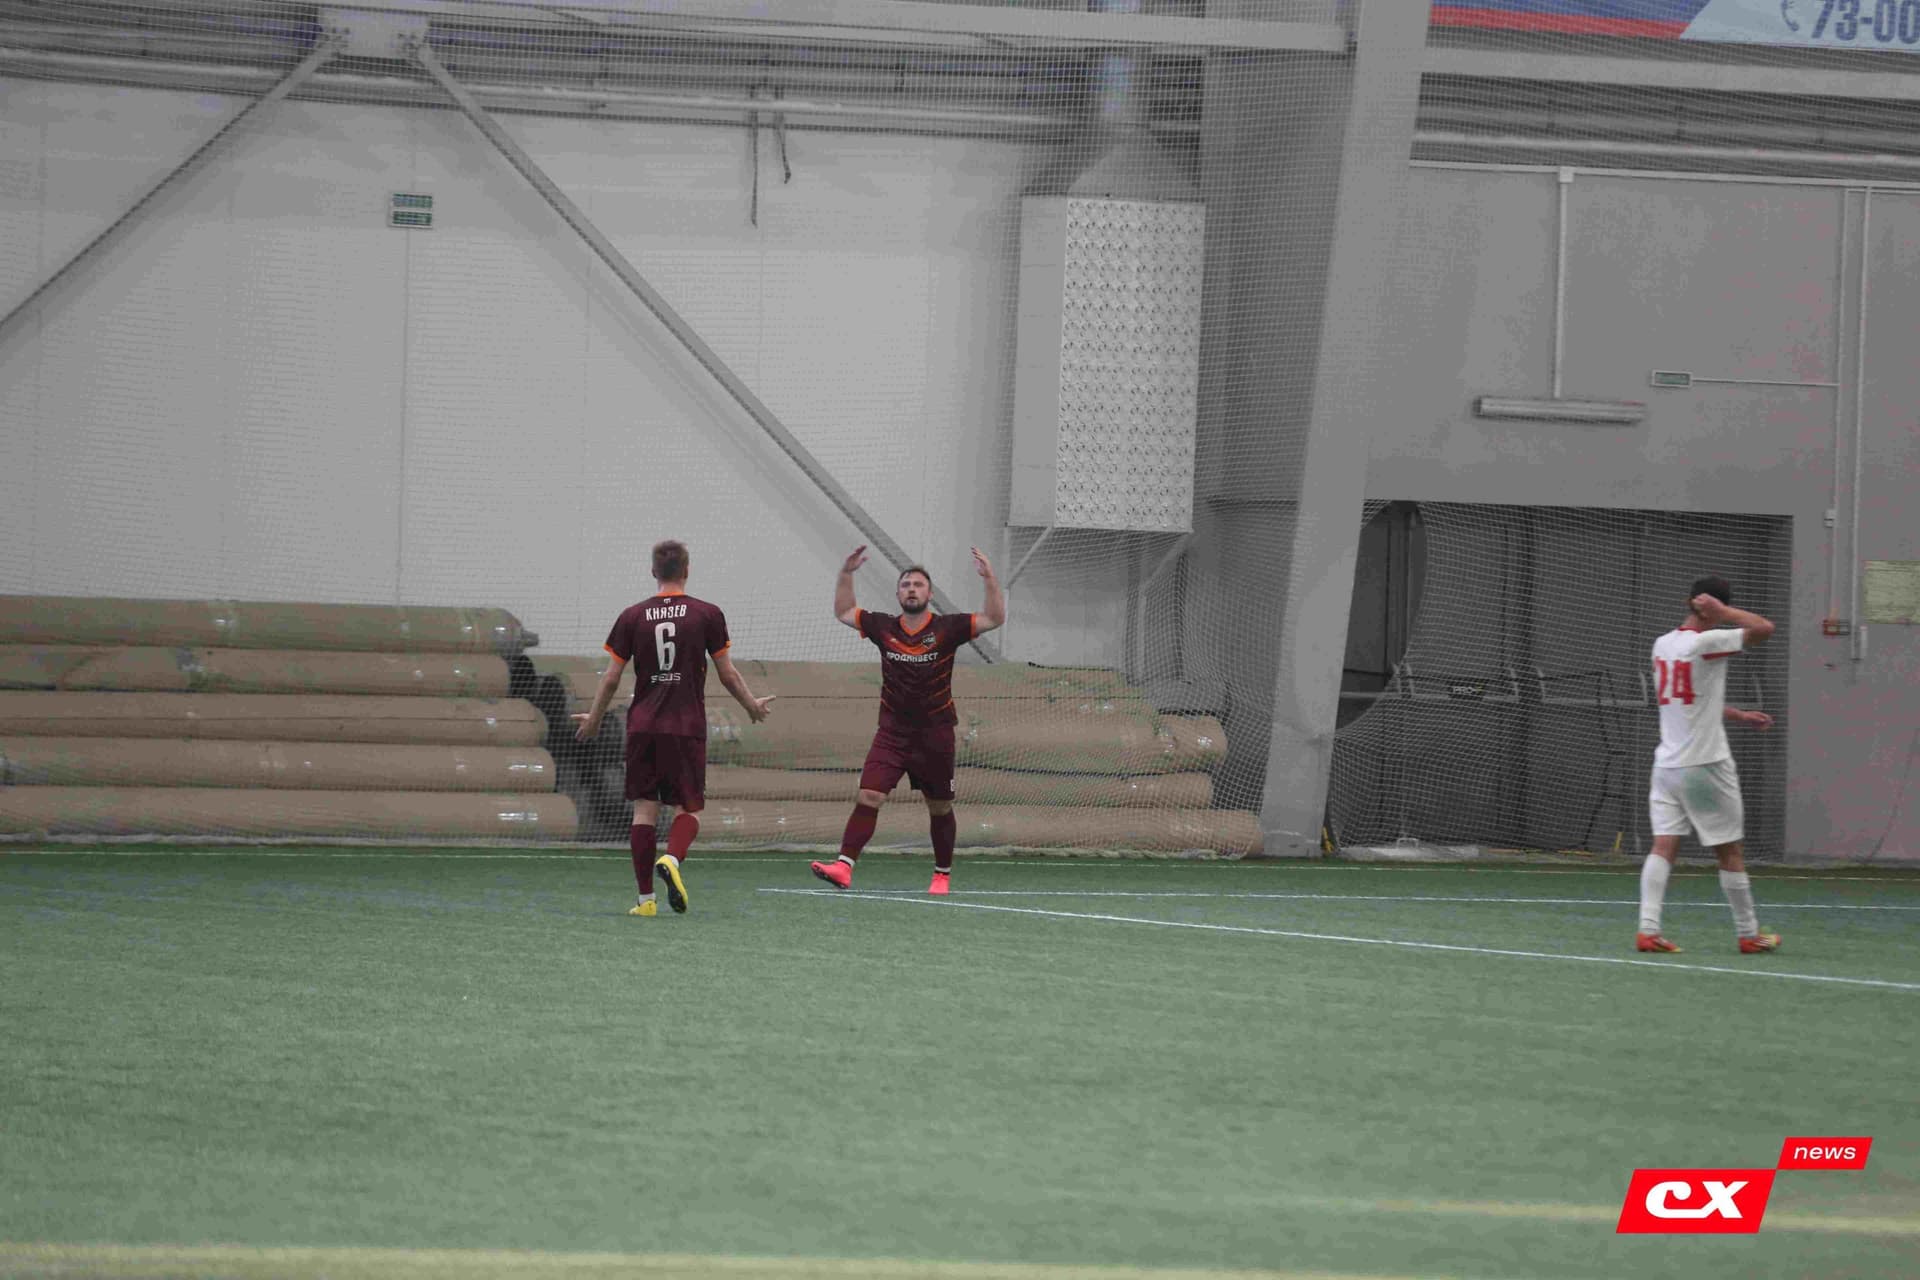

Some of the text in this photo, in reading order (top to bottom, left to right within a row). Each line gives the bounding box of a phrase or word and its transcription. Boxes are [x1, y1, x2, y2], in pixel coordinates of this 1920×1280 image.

[645, 604, 687, 621] КНЯЗЕВ
[655, 622, 676, 671] 6
[1654, 655, 1696, 706] 24
